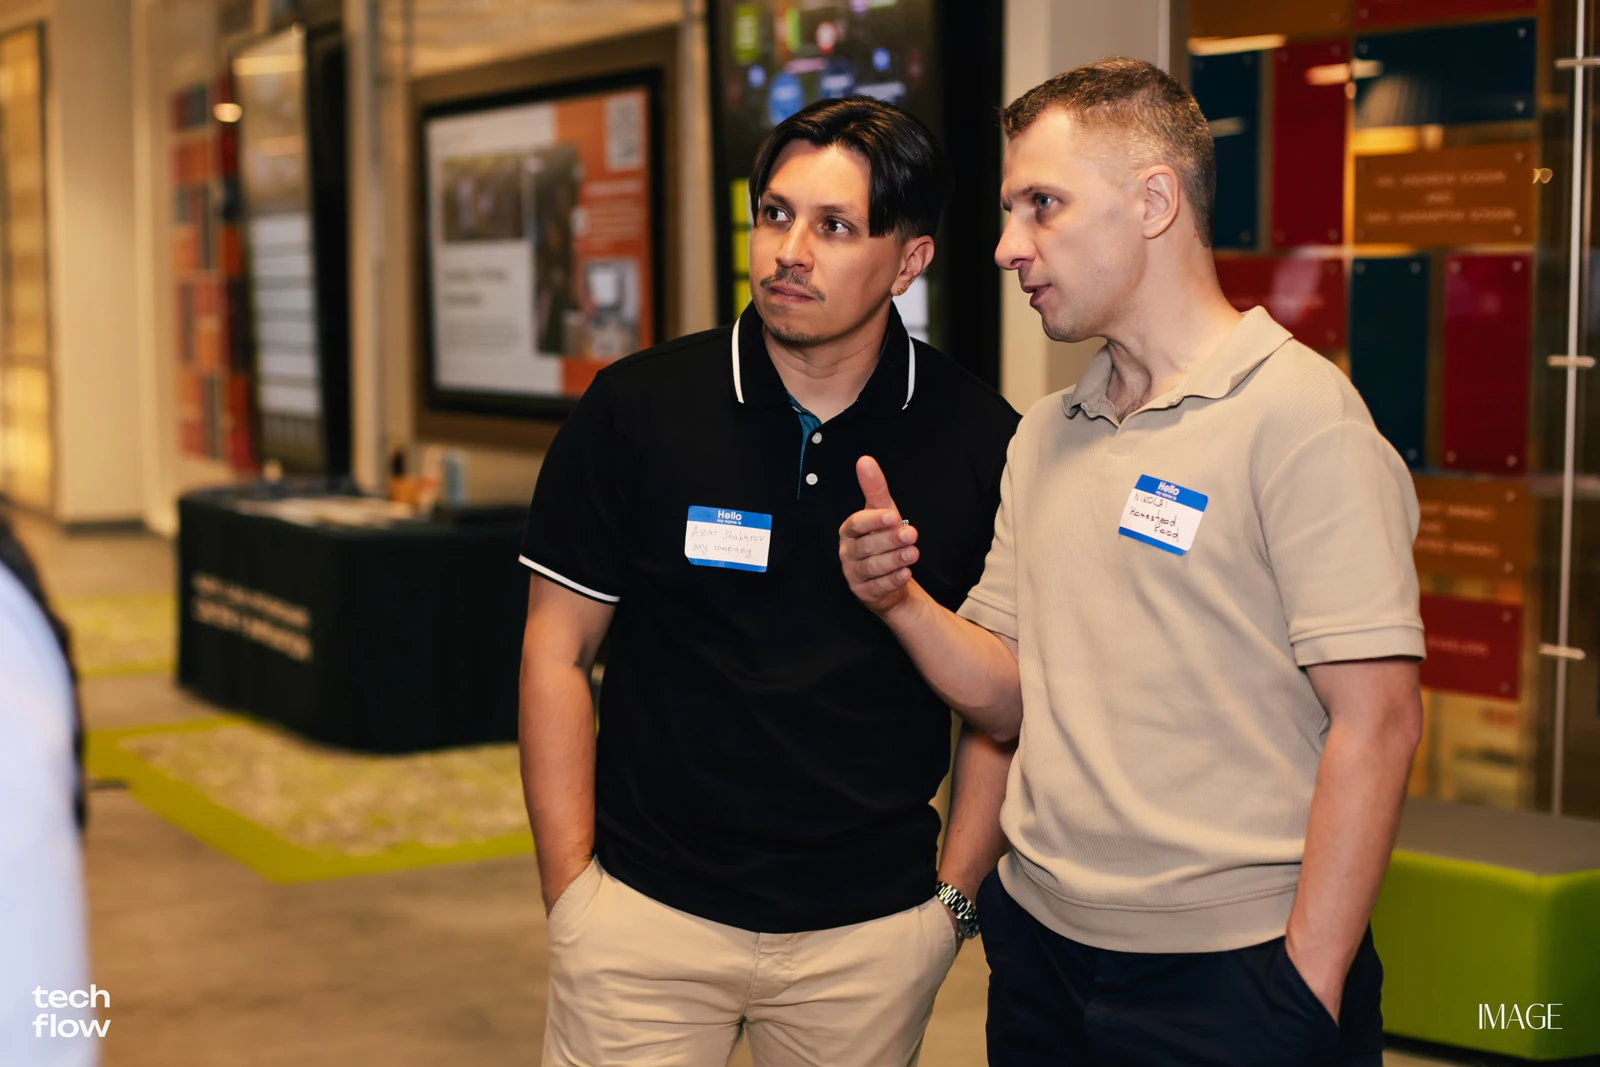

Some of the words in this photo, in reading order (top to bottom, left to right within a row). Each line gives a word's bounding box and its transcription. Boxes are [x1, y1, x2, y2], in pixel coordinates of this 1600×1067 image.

[1157, 481, 1180, 496] Hello
[717, 510, 742, 521] Hello
[714, 545, 752, 559] company
